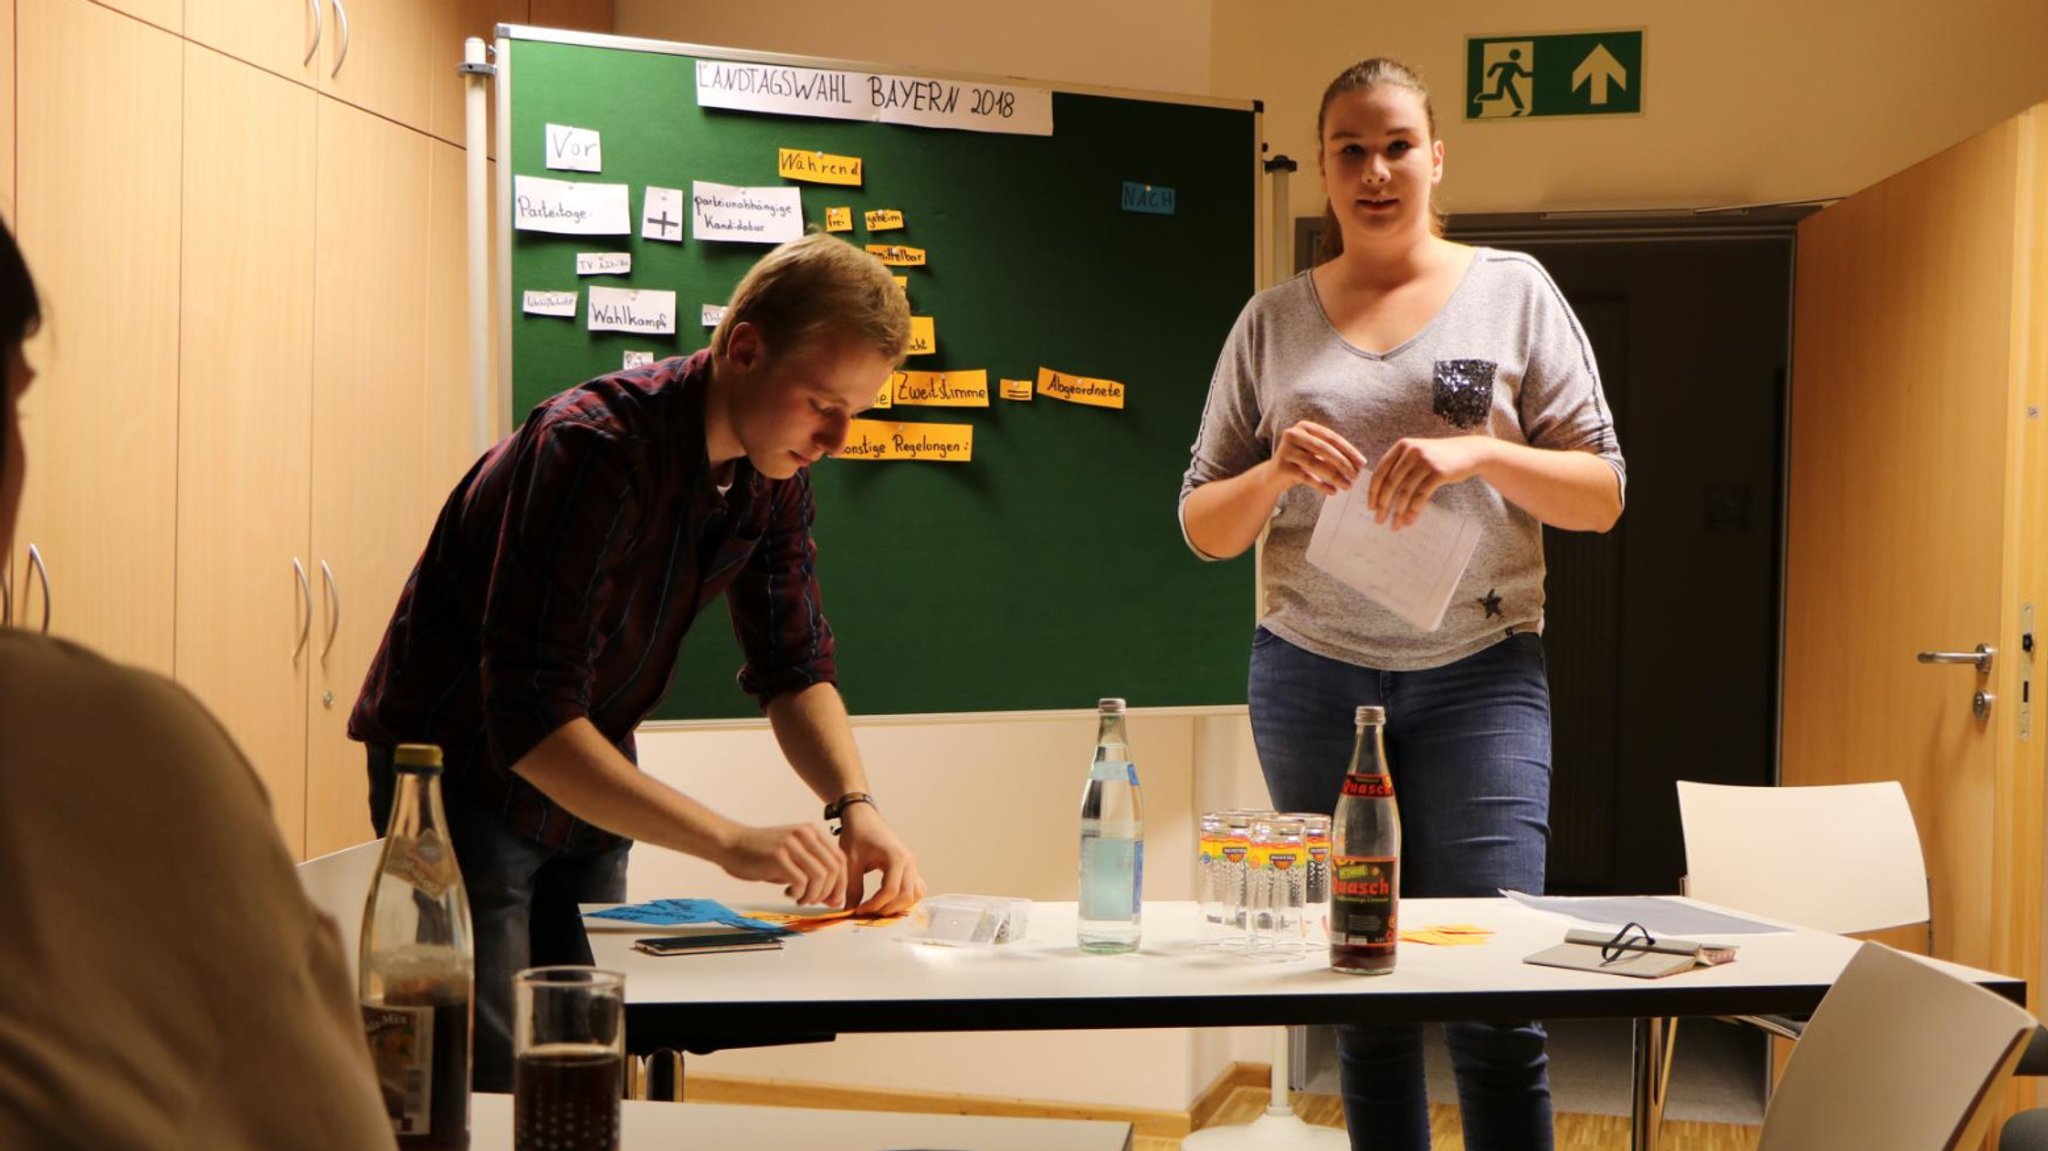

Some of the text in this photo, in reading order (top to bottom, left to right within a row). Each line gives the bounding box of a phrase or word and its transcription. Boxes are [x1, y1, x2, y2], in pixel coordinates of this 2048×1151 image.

[698, 63, 1016, 118] LANDTAGSWAHL BAYERN 2018
[553, 131, 598, 159] Vor
[1124, 185, 1173, 209] NACH
[704, 212, 765, 232] Kandidatur
[827, 213, 845, 228] frei
[867, 212, 901, 229] geheim
[591, 301, 667, 330] Wahlkampf
[898, 372, 986, 400] Zweitstimme
[1046, 373, 1122, 399] Abgeordnete
[842, 434, 887, 458] onstige
